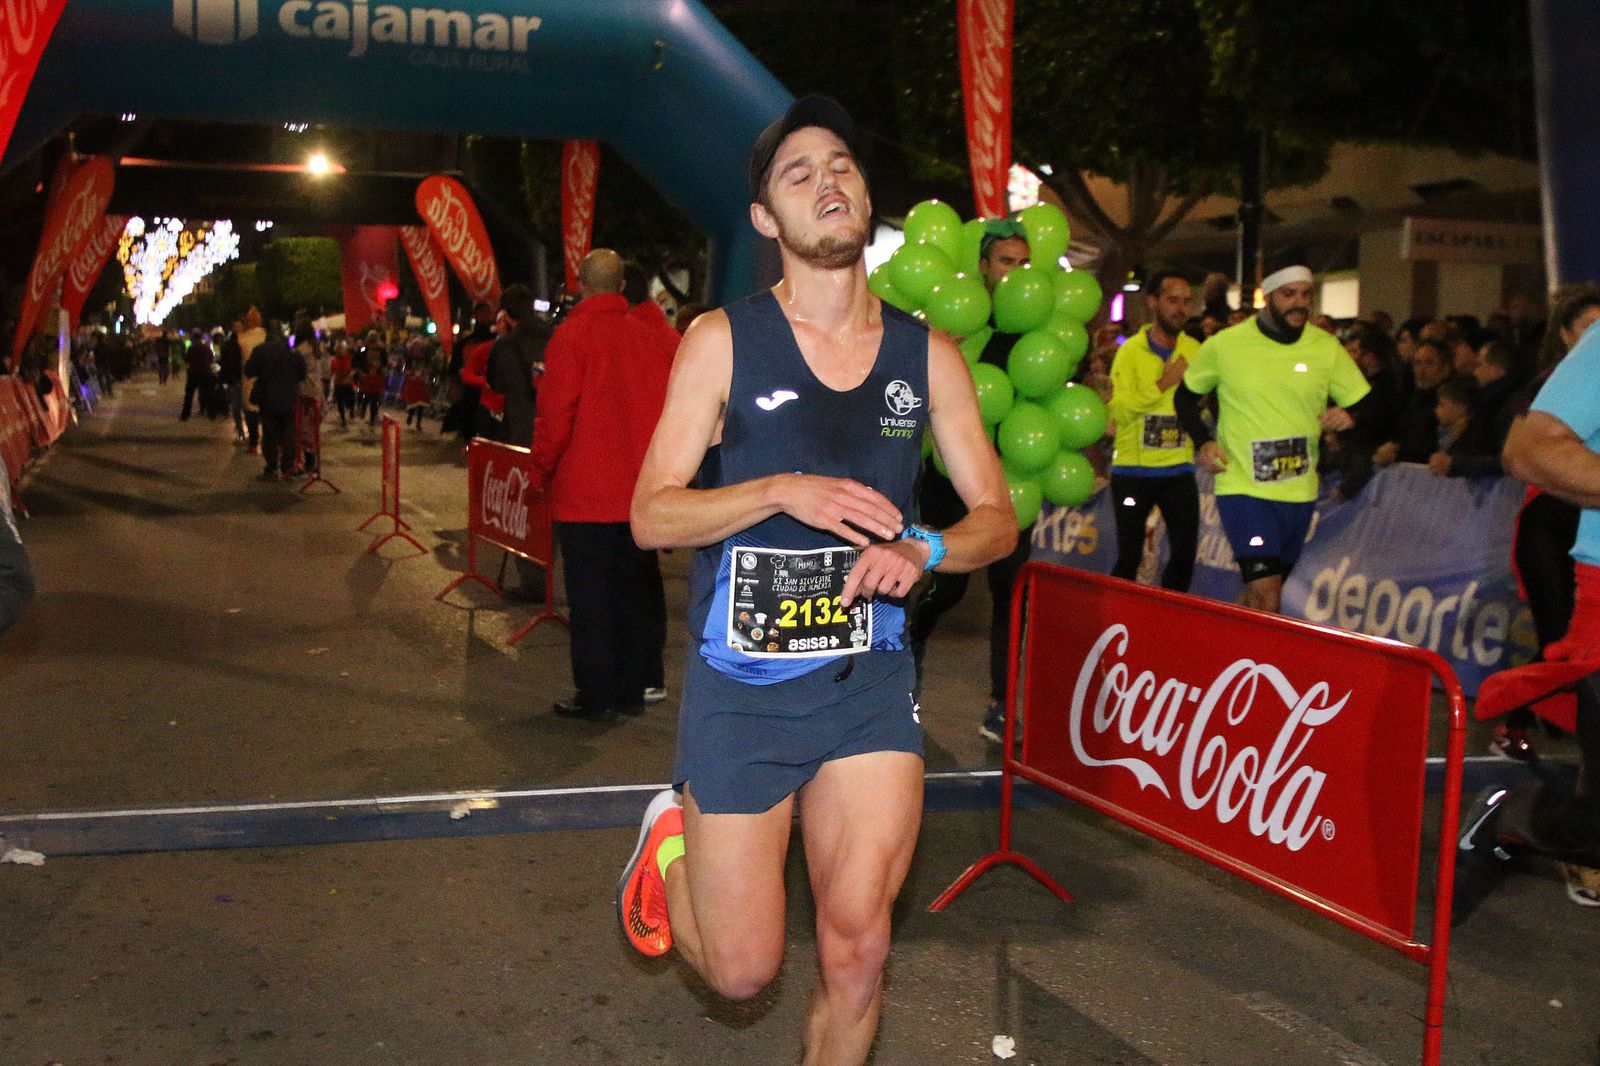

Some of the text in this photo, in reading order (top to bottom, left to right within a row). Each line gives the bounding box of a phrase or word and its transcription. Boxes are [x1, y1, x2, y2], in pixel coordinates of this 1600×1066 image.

[278, 0, 542, 57] cajamar
[879, 417, 917, 428] Universo
[880, 427, 914, 439] Running
[482, 460, 529, 541] Coca-Cola
[784, 578, 798, 586] SAN
[778, 596, 848, 628] 2132
[788, 636, 829, 651] asisa
[1069, 623, 1353, 852] Coca-Cola
